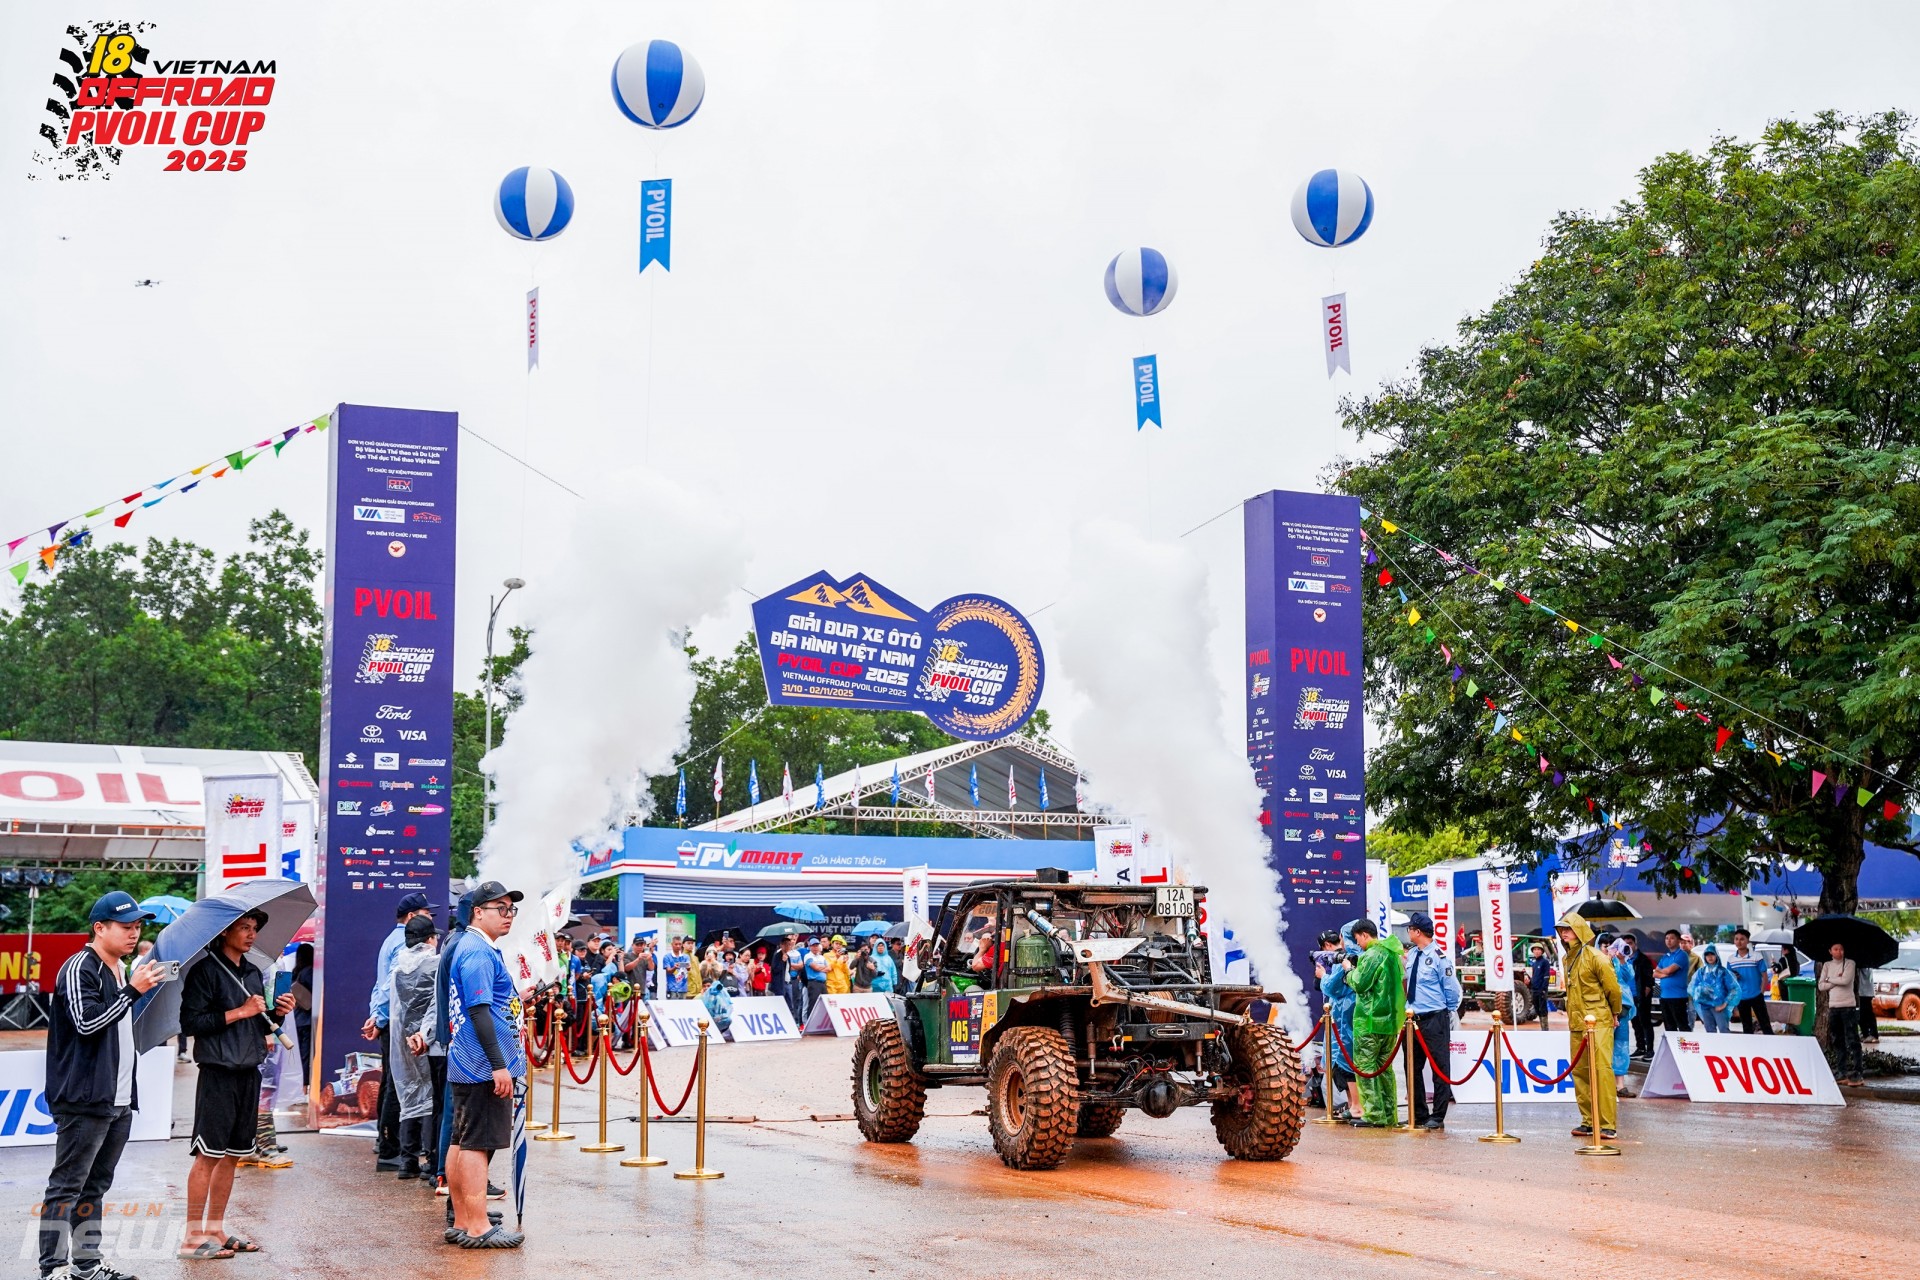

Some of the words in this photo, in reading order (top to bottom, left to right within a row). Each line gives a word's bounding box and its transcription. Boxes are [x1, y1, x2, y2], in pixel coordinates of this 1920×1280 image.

[645, 188, 666, 243] PVOIL
[1327, 303, 1343, 352] PVOIL
[1138, 364, 1155, 407] PVOIL
[354, 587, 437, 620] PVOIL
[788, 612, 821, 633] GIẢI
[824, 624, 859, 640] ĐUA
[861, 626, 885, 644] XE
[887, 628, 922, 650] ÔTÔ
[375, 639, 390, 651] 18
[770, 630, 798, 651] ĐỊA
[801, 632, 838, 656] HÌNH
[840, 642, 878, 664] VIỆT
[880, 652, 916, 668] NAM
[941, 645, 958, 662] 18
[371, 651, 434, 662] OFFROAD
[963, 657, 1009, 671] VIETNAM
[1250, 649, 1270, 668] PVOIL
[1290, 647, 1351, 677] PVOIL
[368, 662, 404, 674] PVOIL
[404, 664, 431, 674] CUP
[777, 652, 826, 674] PVOIL
[829, 660, 863, 679] CUP
[865, 666, 910, 686] 2025
[934, 660, 1008, 682] OFFROAD
[782, 671, 815, 683] VIETNAM
[816, 675, 850, 688] OFFROAD
[851, 680, 872, 691] PVOIL
[872, 684, 888, 694] CUP
[888, 687, 907, 697] 2025
[782, 684, 802, 694] 31/10
[809, 686, 854, 697] 02/11/2025
[929, 672, 972, 693] PVOIL
[972, 678, 1002, 696] CUP
[964, 693, 995, 706] 2025
[376, 704, 412, 720] Ford
[1303, 711, 1328, 721] PVOIL
[1329, 713, 1348, 722] CUP
[397, 730, 427, 741] VISA
[1309, 747, 1335, 761] Ford
[1325, 769, 1347, 778] VISA
[830, 856, 853, 865] HÀNG
[1508, 871, 1528, 884] Ford
[1166, 889, 1185, 901] 12A
[1491, 900, 1503, 951] GWM
[949, 999, 969, 1019] PVOIL
[738, 1013, 787, 1035] VISA
[951, 1020, 968, 1043] 405
[1704, 1055, 1813, 1096] PVOIL
